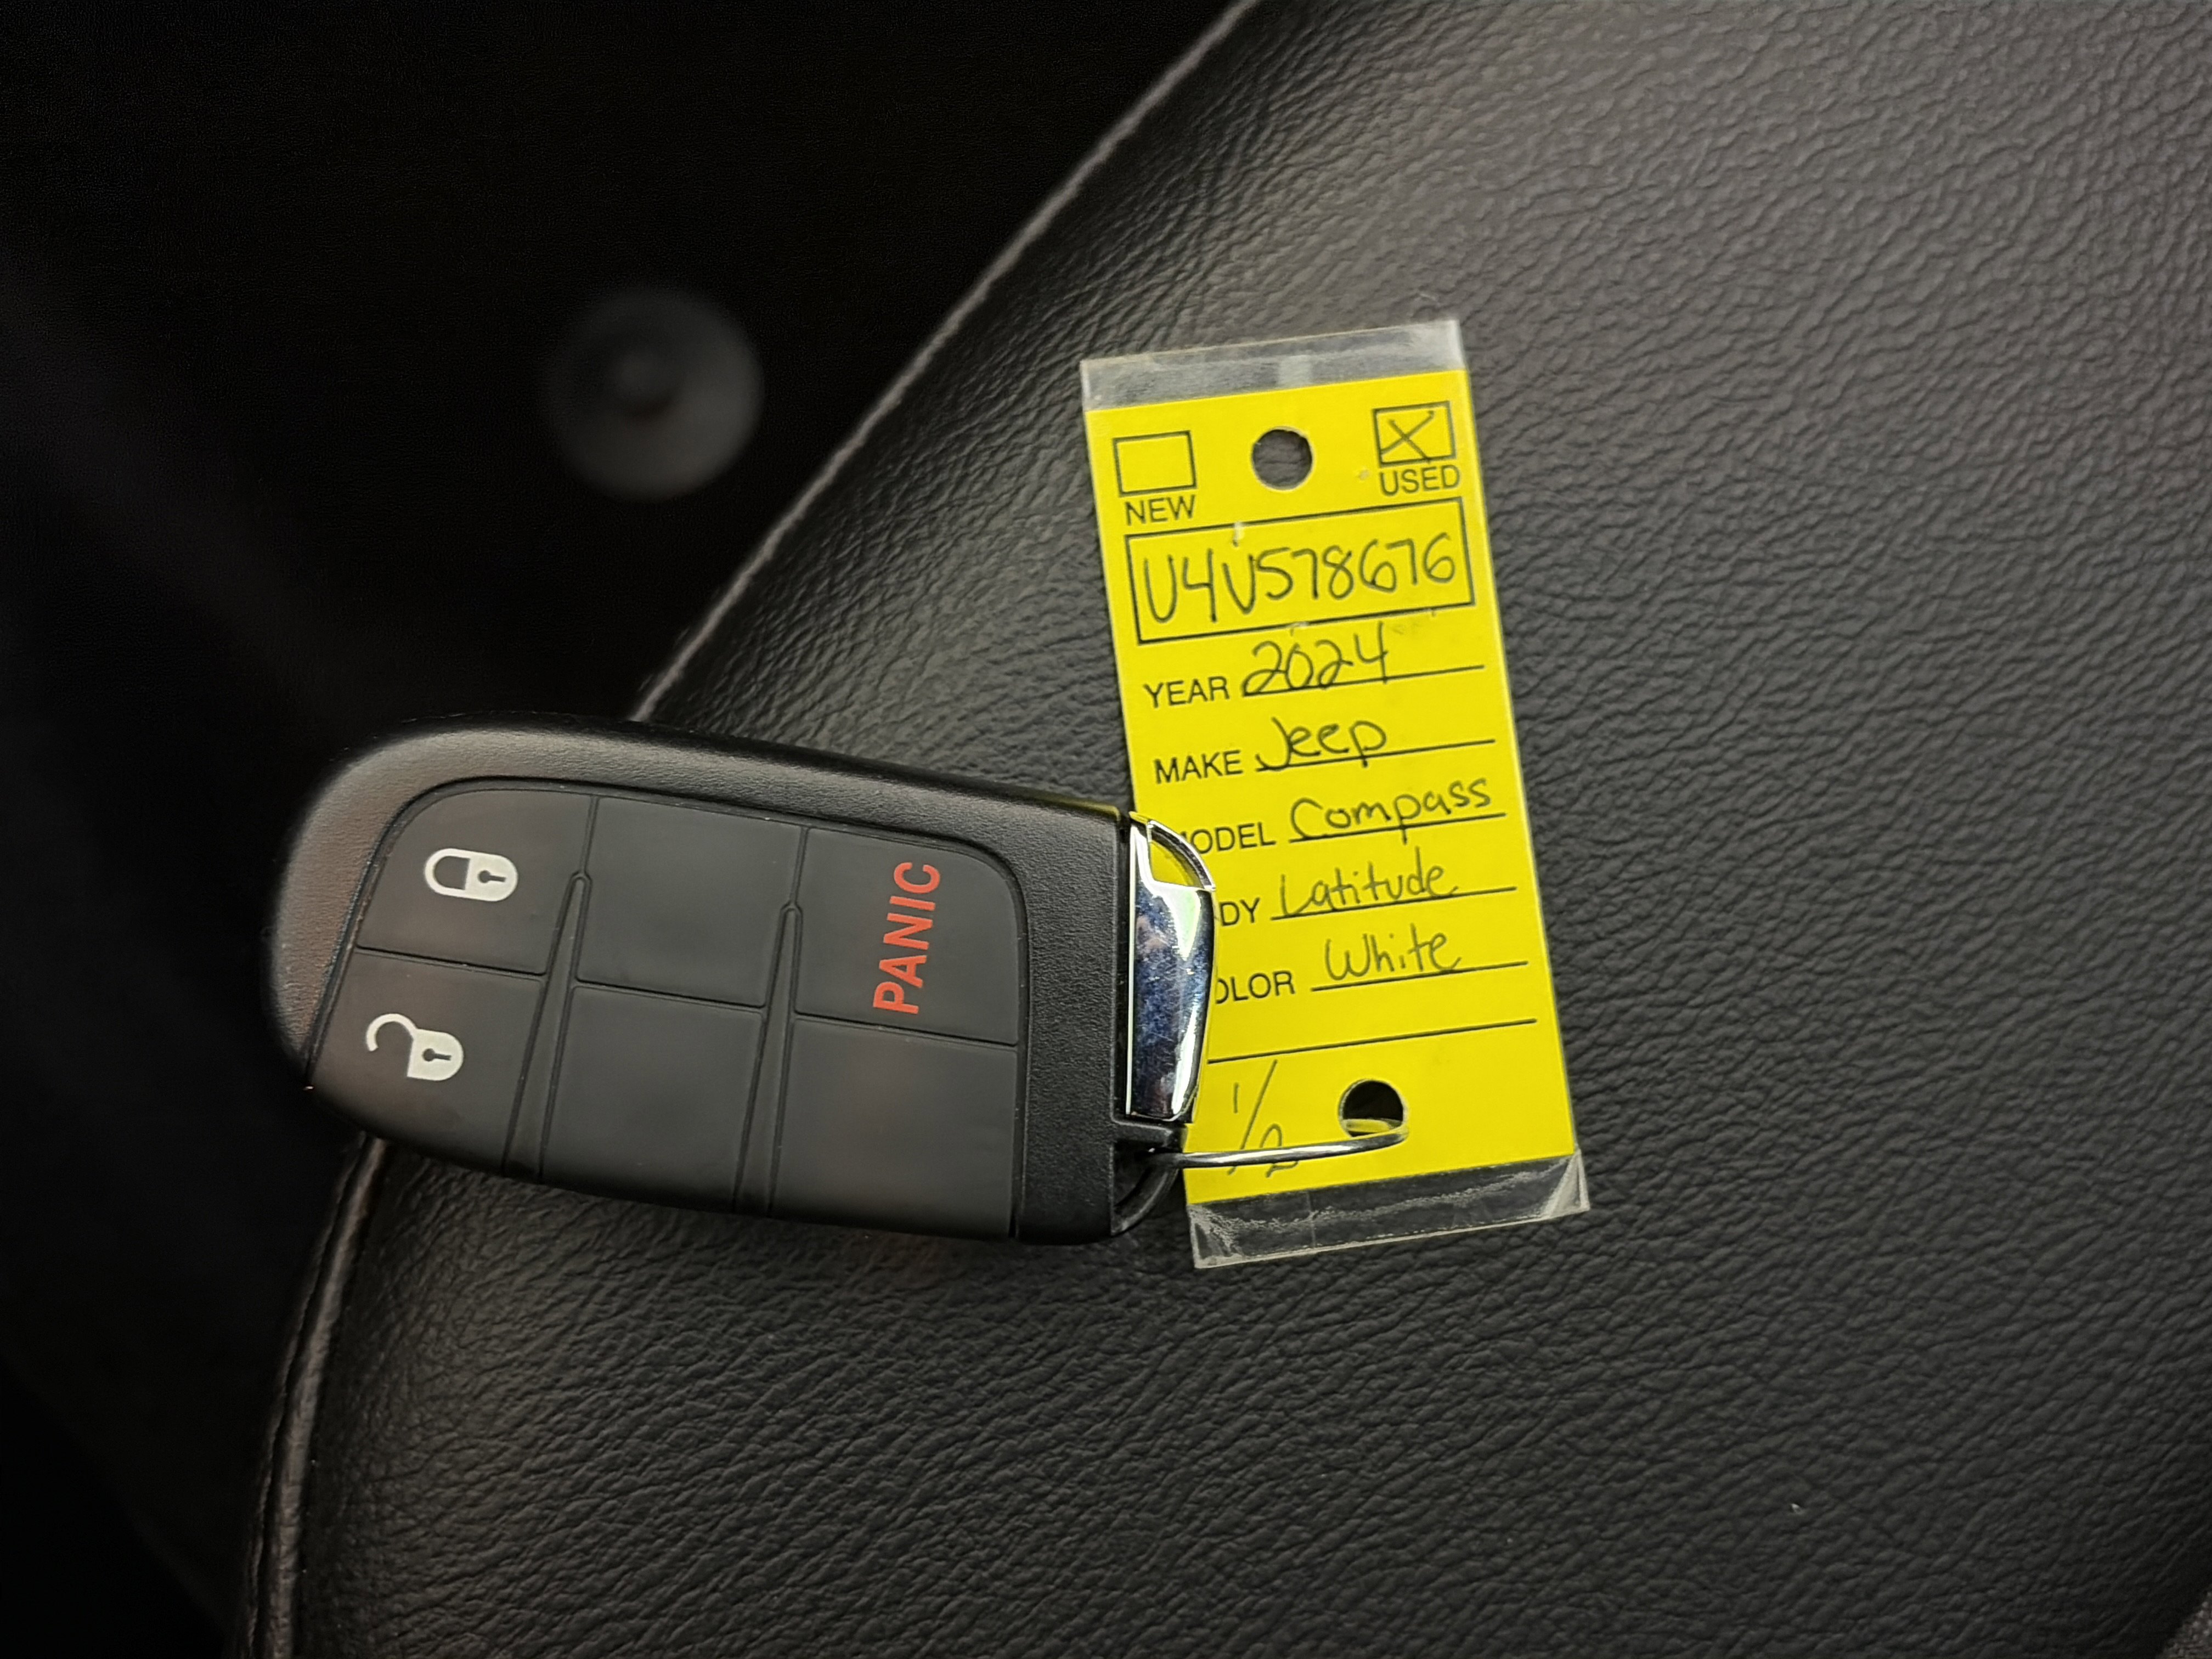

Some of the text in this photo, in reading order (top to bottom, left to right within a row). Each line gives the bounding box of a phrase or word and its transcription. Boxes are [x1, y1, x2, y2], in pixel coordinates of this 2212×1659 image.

[1124, 495, 1197, 525] NEW
[1378, 465, 1462, 496] USED
[1144, 532, 1457, 624] U4V578676
[1144, 621, 1389, 708] YEAR 2024
[1154, 716, 1387, 784] MAKE Jeep
[1180, 778, 1491, 854] ODEL Compass
[1218, 847, 1458, 927] DY Latitude
[873, 861, 940, 1015] PANIC
[1216, 924, 1462, 1005] OLOR White
